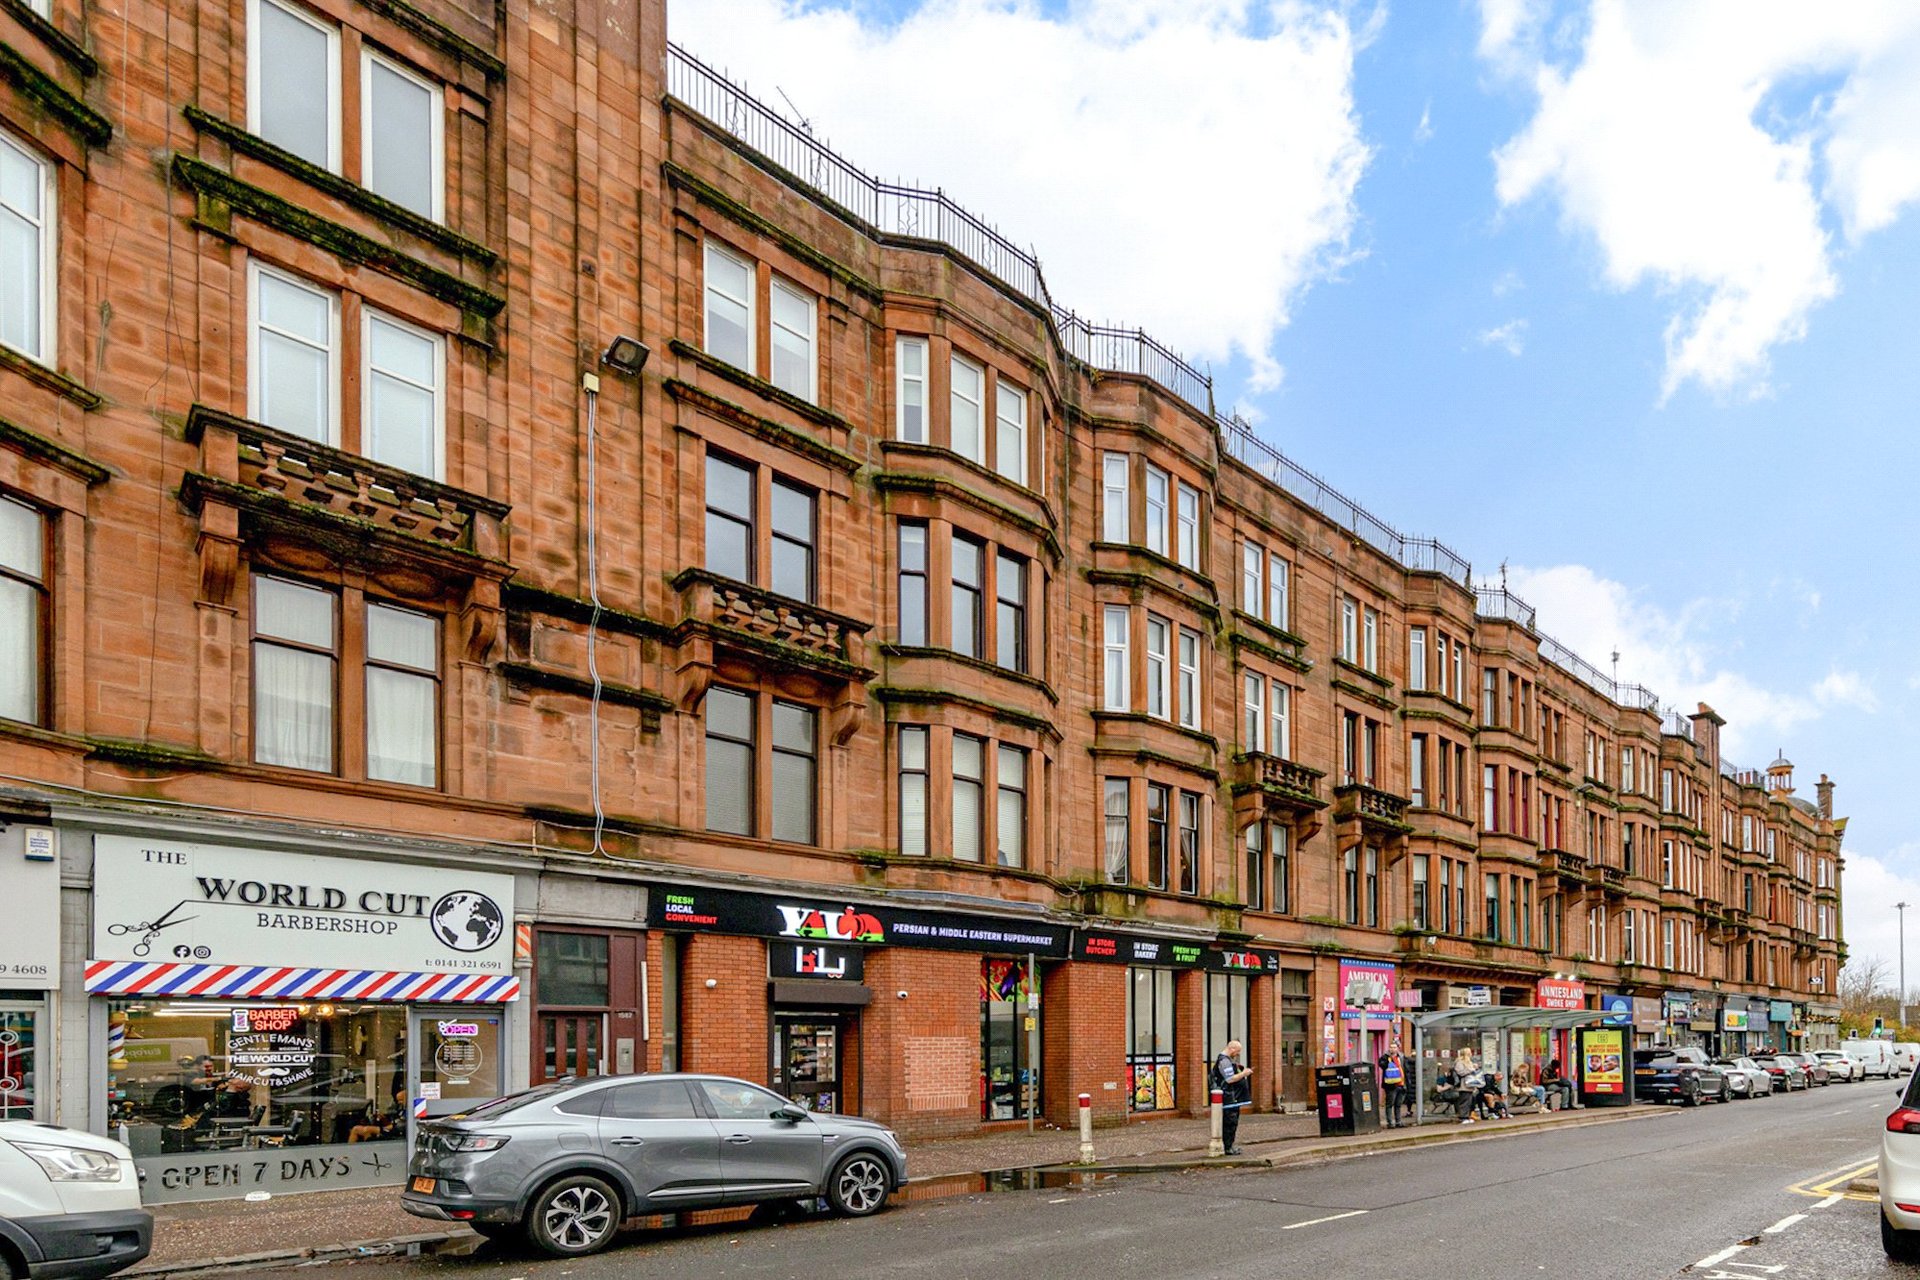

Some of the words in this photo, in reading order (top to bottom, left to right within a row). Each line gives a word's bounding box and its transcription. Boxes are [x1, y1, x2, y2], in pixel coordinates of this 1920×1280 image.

[141, 849, 188, 866] THE
[196, 876, 346, 909] WORLD
[359, 890, 430, 916] CUT
[666, 895, 694, 905] FRESH
[665, 904, 694, 914] LOCAL
[257, 912, 398, 935] BARBERSHOP
[665, 913, 718, 924] CONVENIENT
[893, 923, 929, 935] PERSIAN
[930, 926, 937, 936] &
[938, 927, 968, 938] MIDDLE
[969, 930, 1002, 941] EASTERN
[1003, 932, 1053, 945] SUPERMARKET
[1088, 938, 1096, 946] IN
[1096, 938, 1116, 948] STORE
[1133, 942, 1141, 950] IN
[1141, 942, 1159, 952] STORE
[1086, 945, 1117, 956] BUTCHERY
[1134, 950, 1157, 960] BAKERY
[1173, 945, 1190, 955] FRESH
[12, 964, 47, 975] 4608
[435, 958, 458, 968] 0141
[460, 960, 478, 969] 321
[480, 961, 502, 970] 6591
[1347, 969, 1389, 985] AMERICAN
[1540, 985, 1583, 999] ANNIESLAND
[1546, 999, 1564, 1007] SMOKE
[1565, 1000, 1578, 1009] SHOP
[249, 1009, 297, 1021] BARBER
[254, 1020, 291, 1031] SHOP
[446, 1025, 476, 1035] OPEN
[227, 1033, 315, 1049] GENTLEMAN'S
[228, 1054, 250, 1063] THE
[250, 1054, 292, 1063] WORLD
[292, 1054, 315, 1063] CUT
[162, 1163, 241, 1190] OPEN
[253, 1161, 269, 1184] 7
[281, 1155, 352, 1181] DAYS
